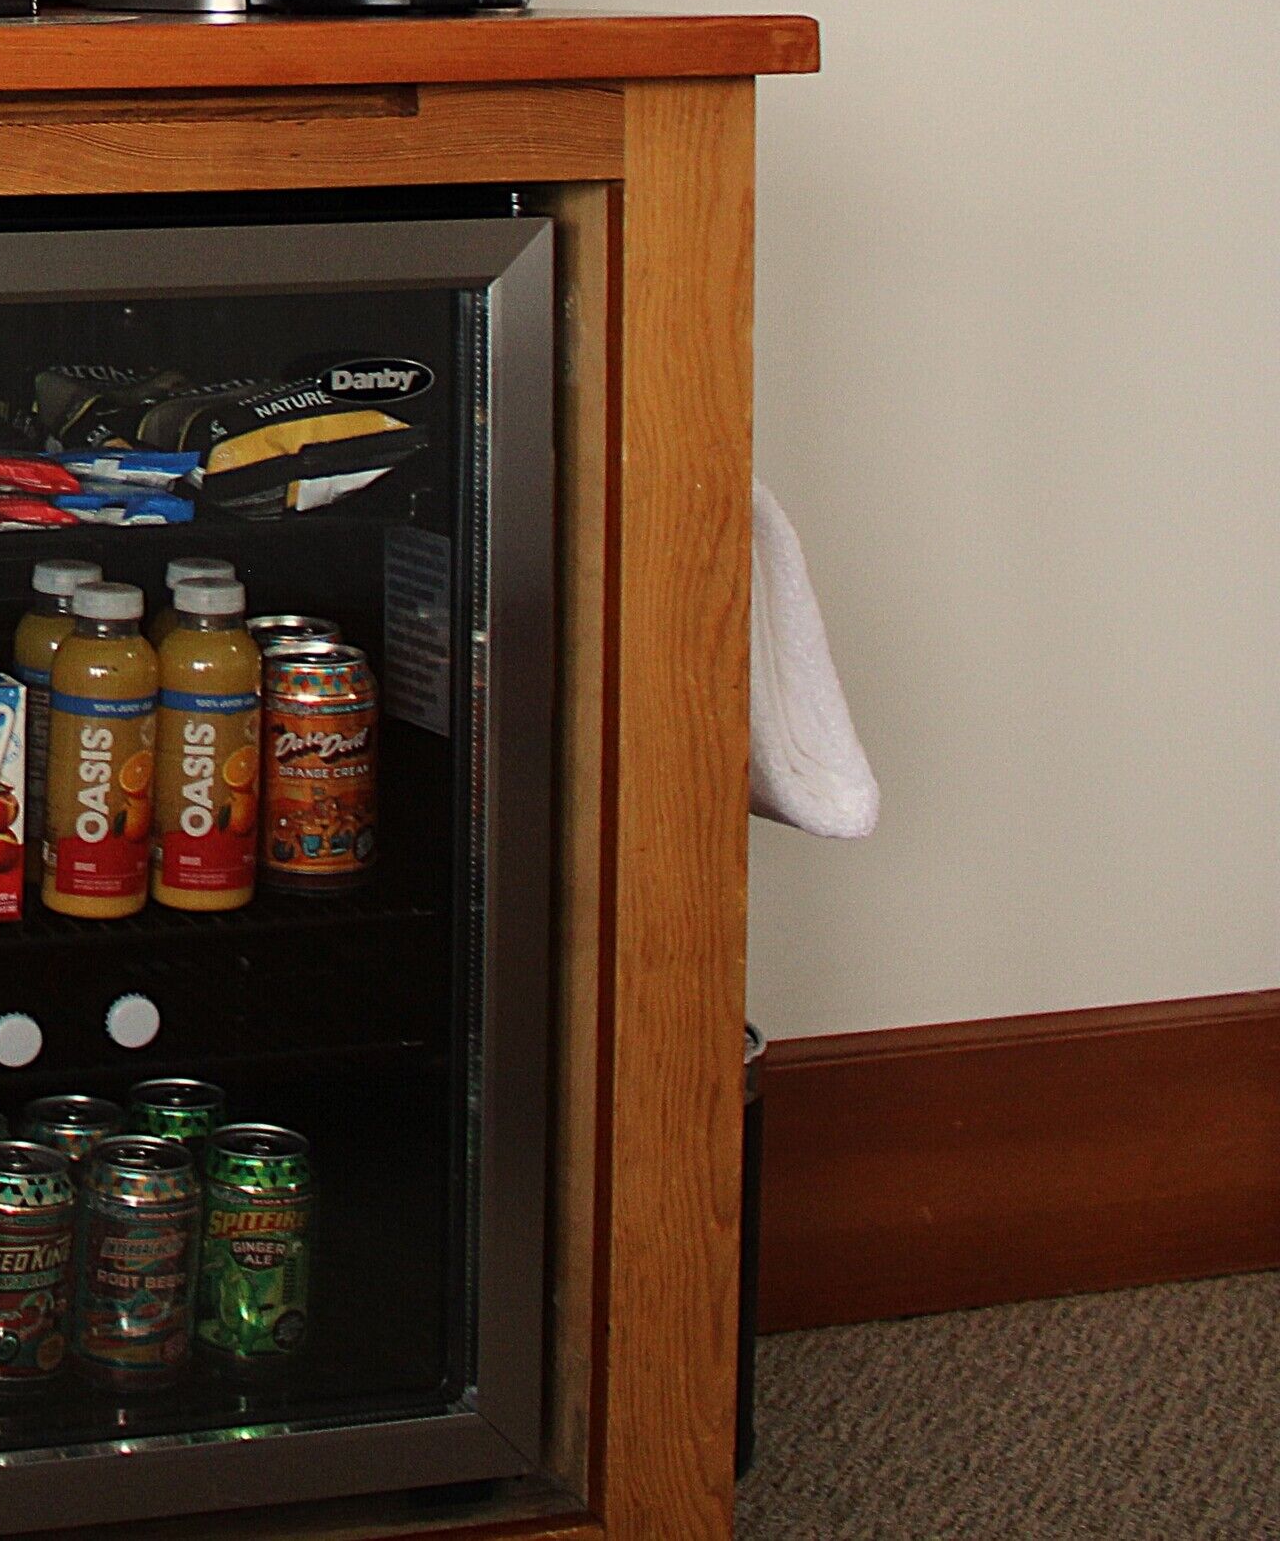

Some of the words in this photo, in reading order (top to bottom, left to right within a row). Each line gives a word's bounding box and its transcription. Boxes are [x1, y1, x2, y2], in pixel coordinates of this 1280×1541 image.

[330, 368, 421, 392] Danby
[253, 389, 334, 419] NATURE
[179, 721, 217, 838] OASIS
[278, 765, 330, 779] ORANGE
[75, 726, 114, 843] OASIS
[232, 1240, 287, 1255] GINGER
[243, 1255, 273, 1267] ALE
